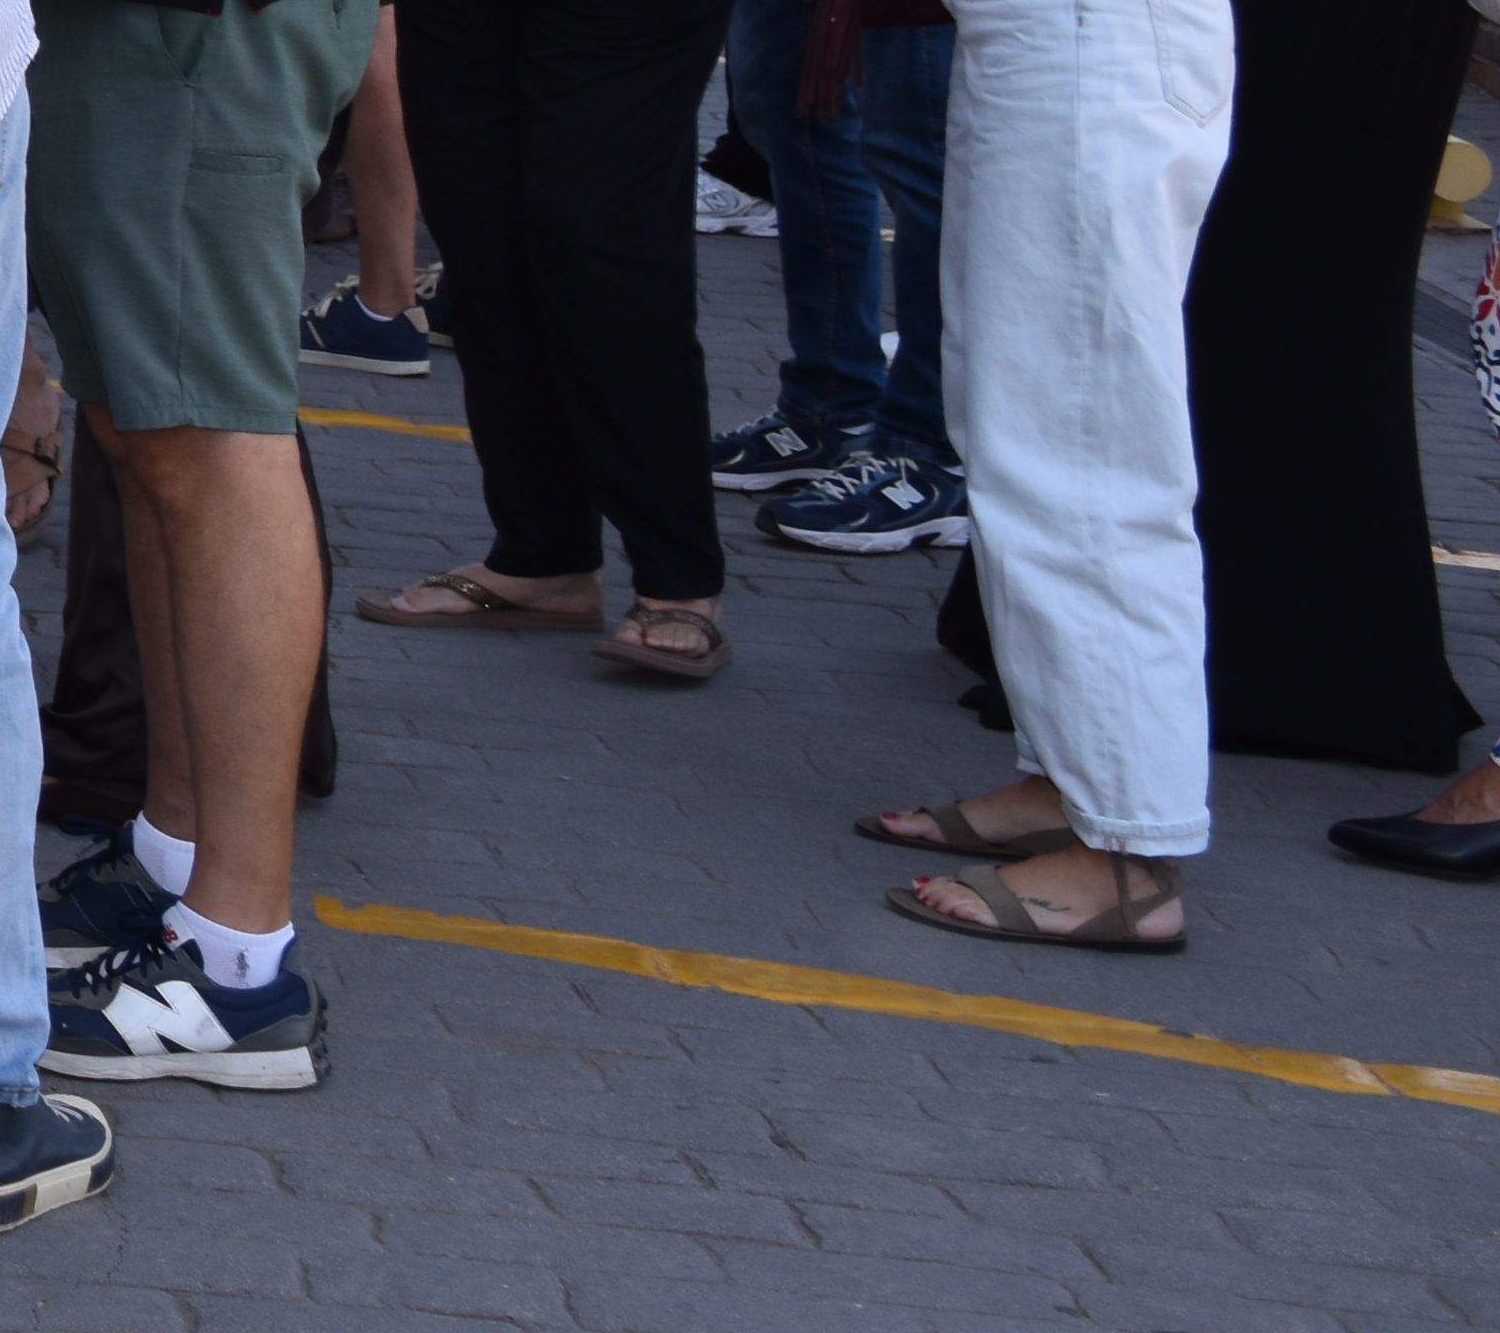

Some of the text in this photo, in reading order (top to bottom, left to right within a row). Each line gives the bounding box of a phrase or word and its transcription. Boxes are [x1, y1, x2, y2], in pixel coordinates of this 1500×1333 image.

[764, 426, 808, 457] N
[880, 479, 925, 510] N
[101, 980, 236, 1056] N
